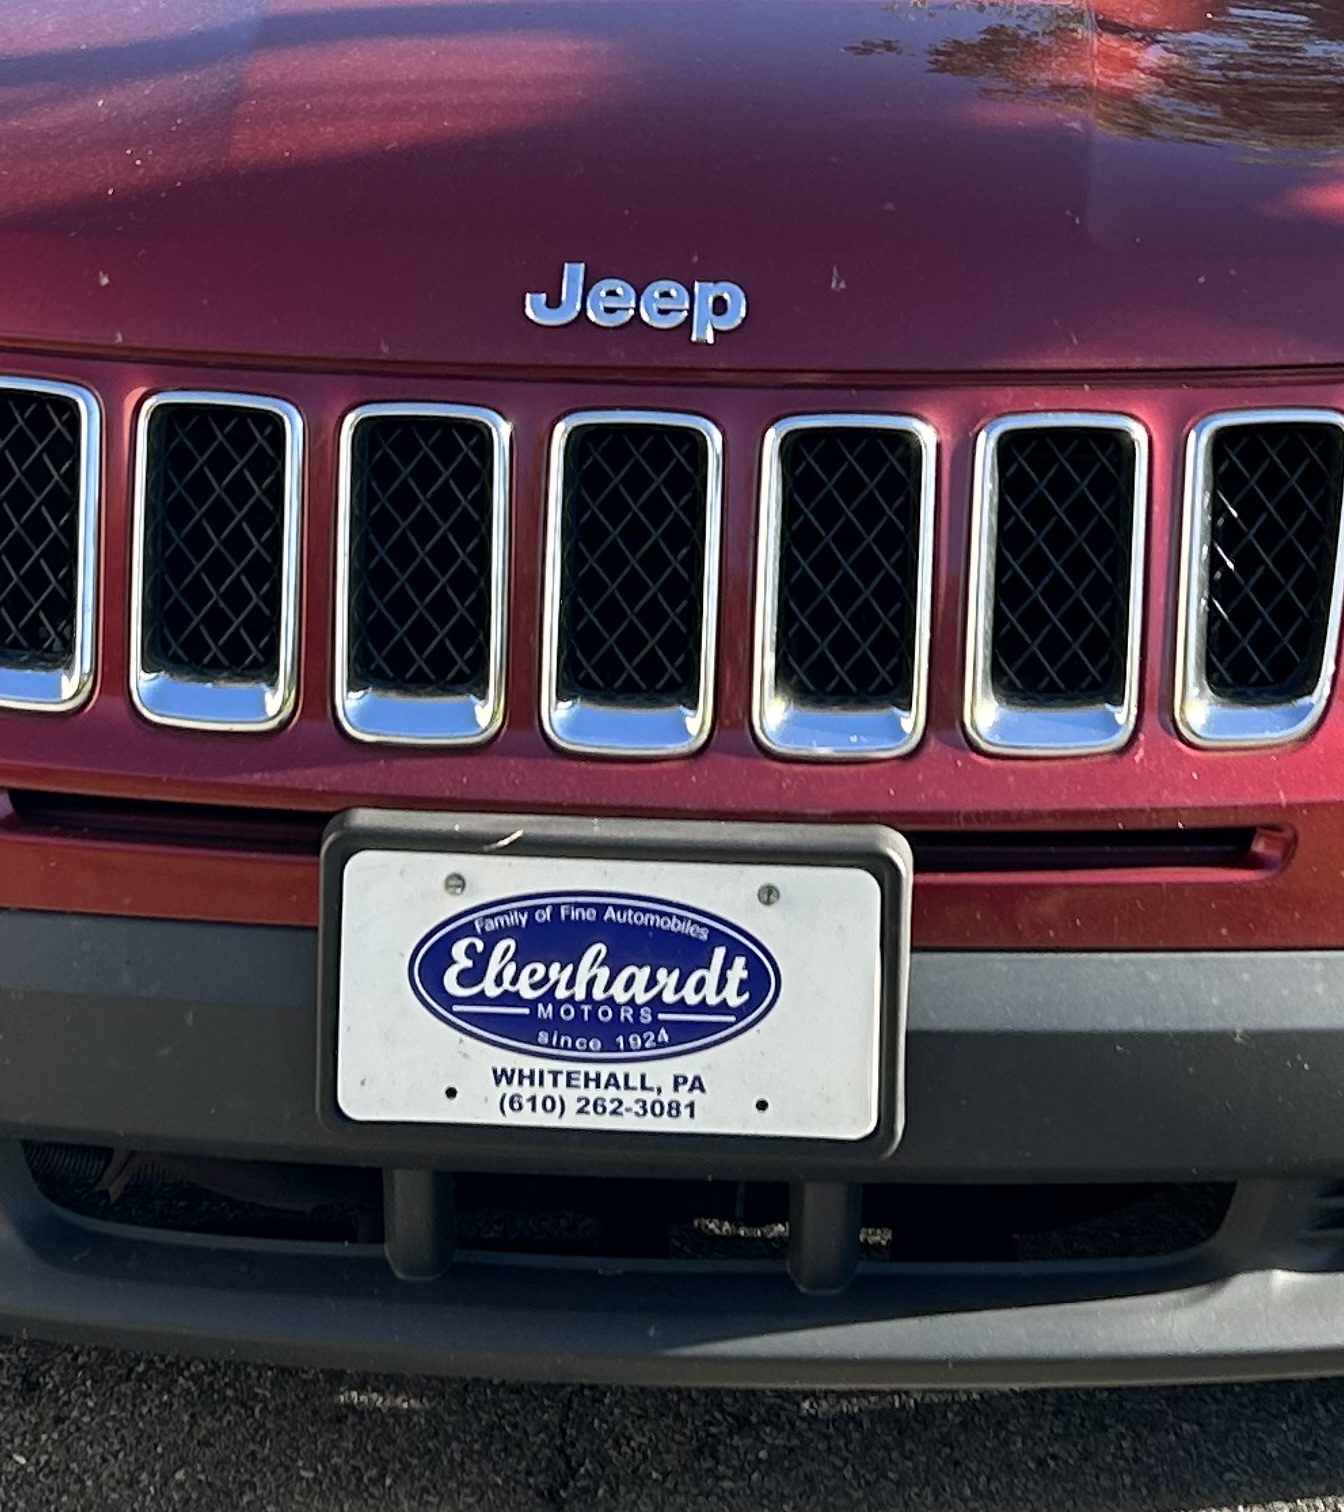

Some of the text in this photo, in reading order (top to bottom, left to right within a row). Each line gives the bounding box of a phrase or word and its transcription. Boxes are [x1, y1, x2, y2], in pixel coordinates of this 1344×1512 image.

[524, 261, 748, 345] Jeep
[473, 904, 710, 941] Family of Fine Automobiles
[442, 935, 750, 1008] Eberhardt
[537, 1002, 653, 1025] MOTORS
[537, 1026, 670, 1052] since 1924
[491, 1066, 707, 1096] WHITEHALL, PA
[498, 1092, 696, 1119] (610) 262-3081
